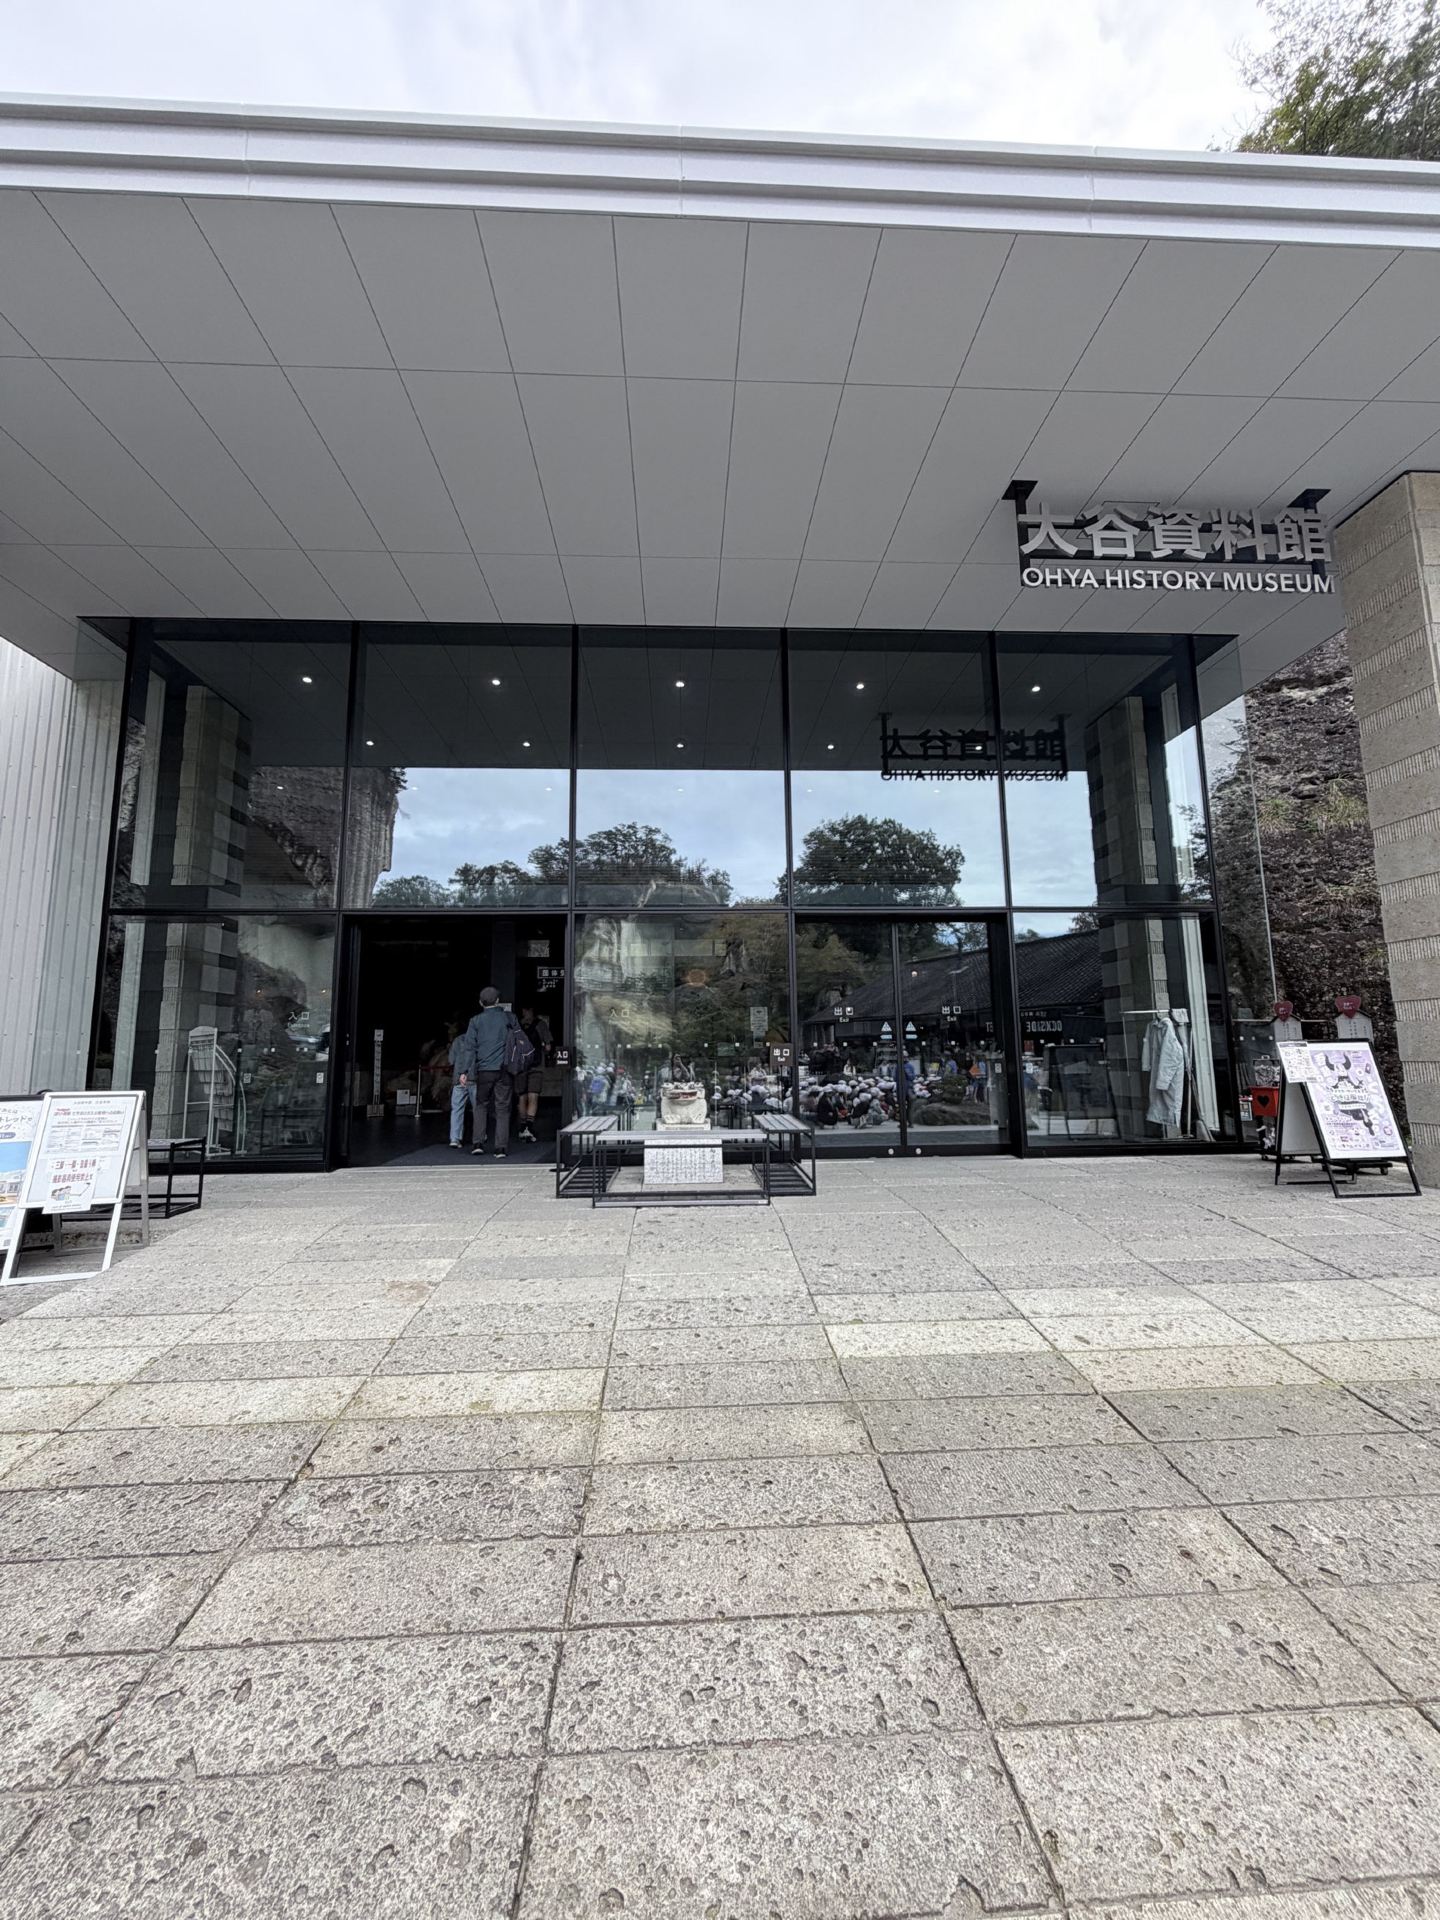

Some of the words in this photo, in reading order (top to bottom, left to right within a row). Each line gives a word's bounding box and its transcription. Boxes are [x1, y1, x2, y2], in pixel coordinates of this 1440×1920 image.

[1018, 502, 1331, 562] 大谷資料館
[1022, 567, 1099, 588] OHYA
[1105, 568, 1216, 591] HISTORY
[1223, 572, 1336, 593] MUSEUM
[610, 1009, 630, 1017] 入口
[834, 1007, 853, 1016] 出口
[942, 1006, 961, 1014] 出口
[288, 1011, 310, 1020] 入口
[556, 1050, 568, 1058] 入口
